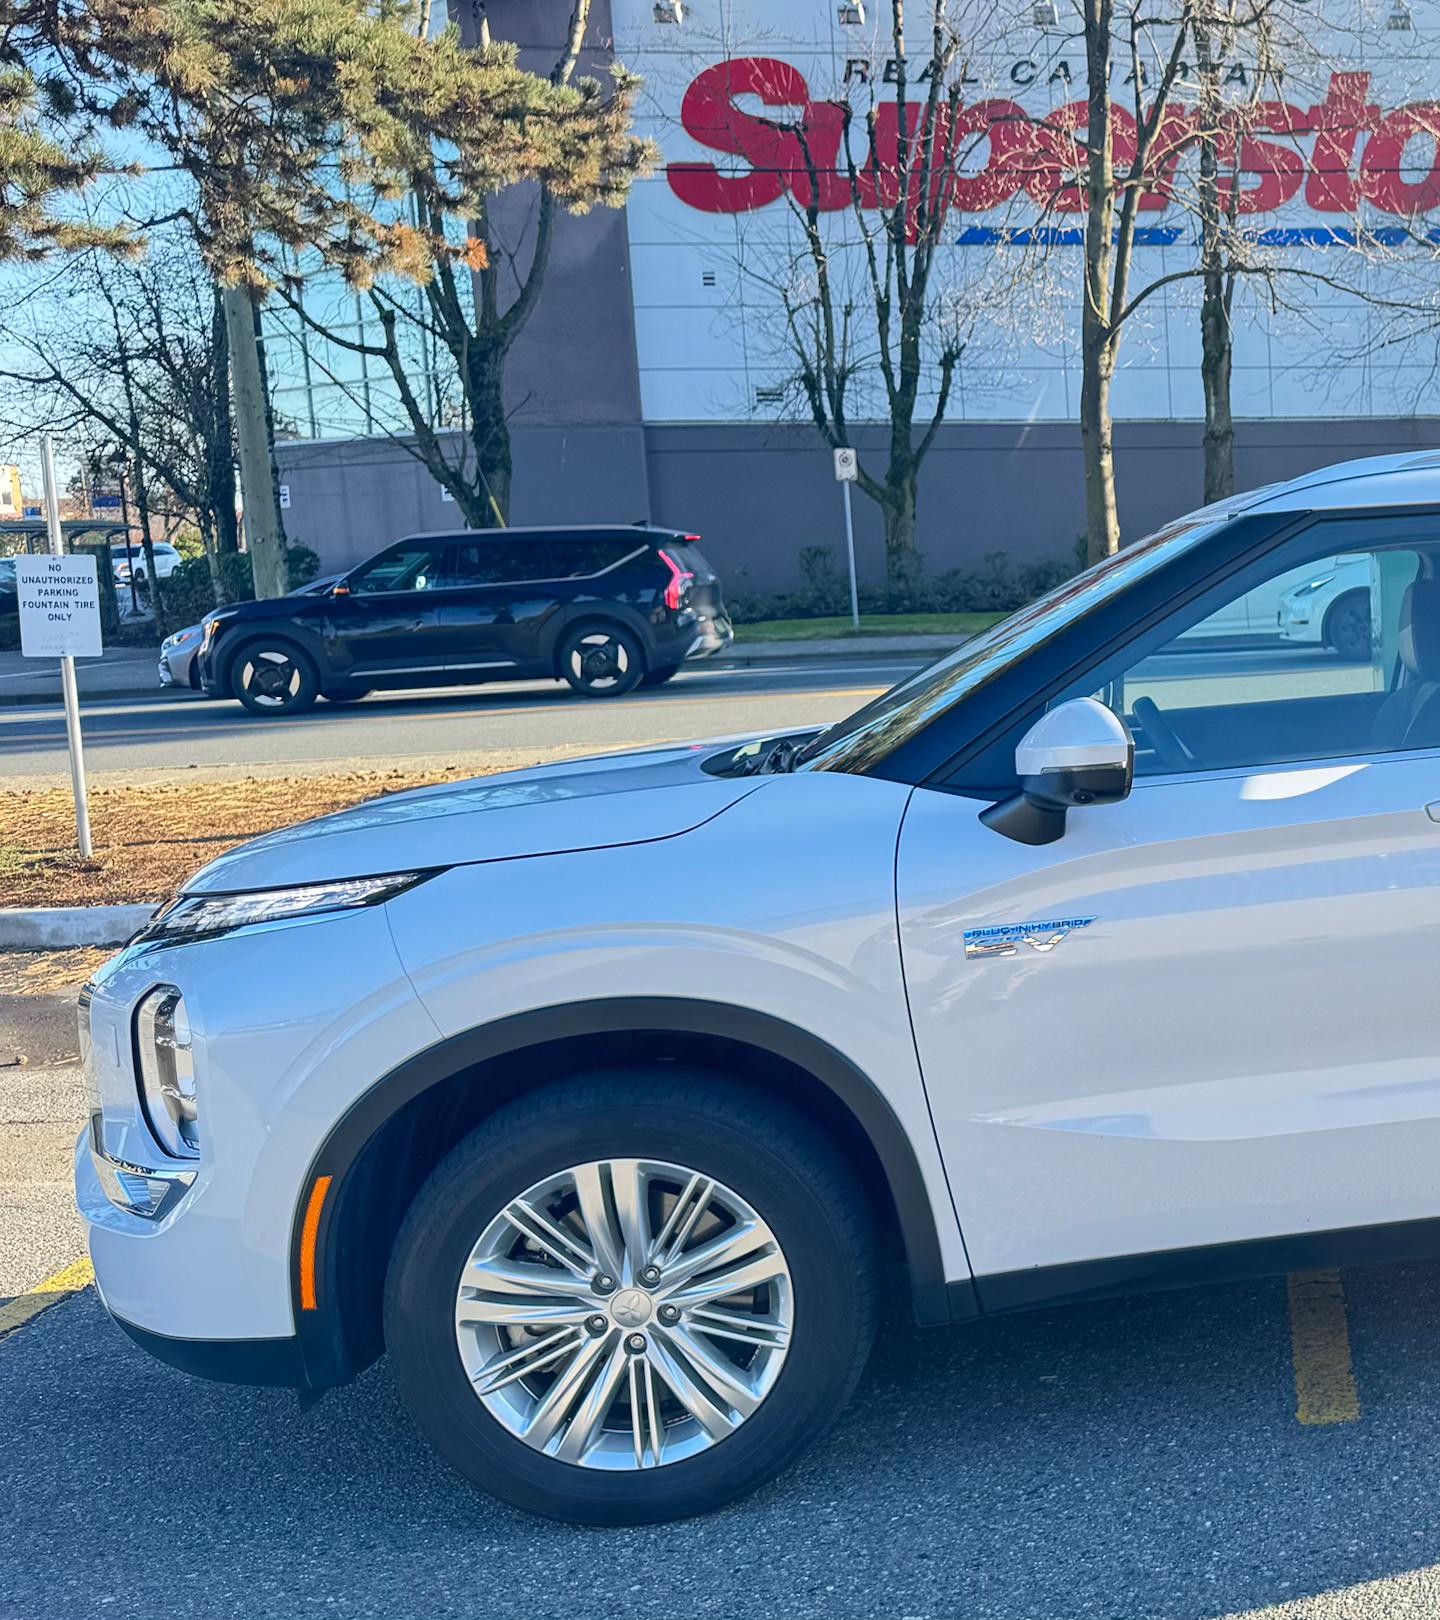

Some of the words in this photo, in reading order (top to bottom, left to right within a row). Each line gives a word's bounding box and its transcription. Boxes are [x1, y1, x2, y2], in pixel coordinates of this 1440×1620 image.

[843, 59, 978, 84] REAL
[48, 564, 62, 572] NO
[21, 576, 94, 584] UNAUTHORIZED
[37, 588, 79, 597] PARKING
[22, 601, 69, 609] FOUNTAIN
[74, 601, 96, 609] TIRE
[47, 613, 73, 621] ONLY
